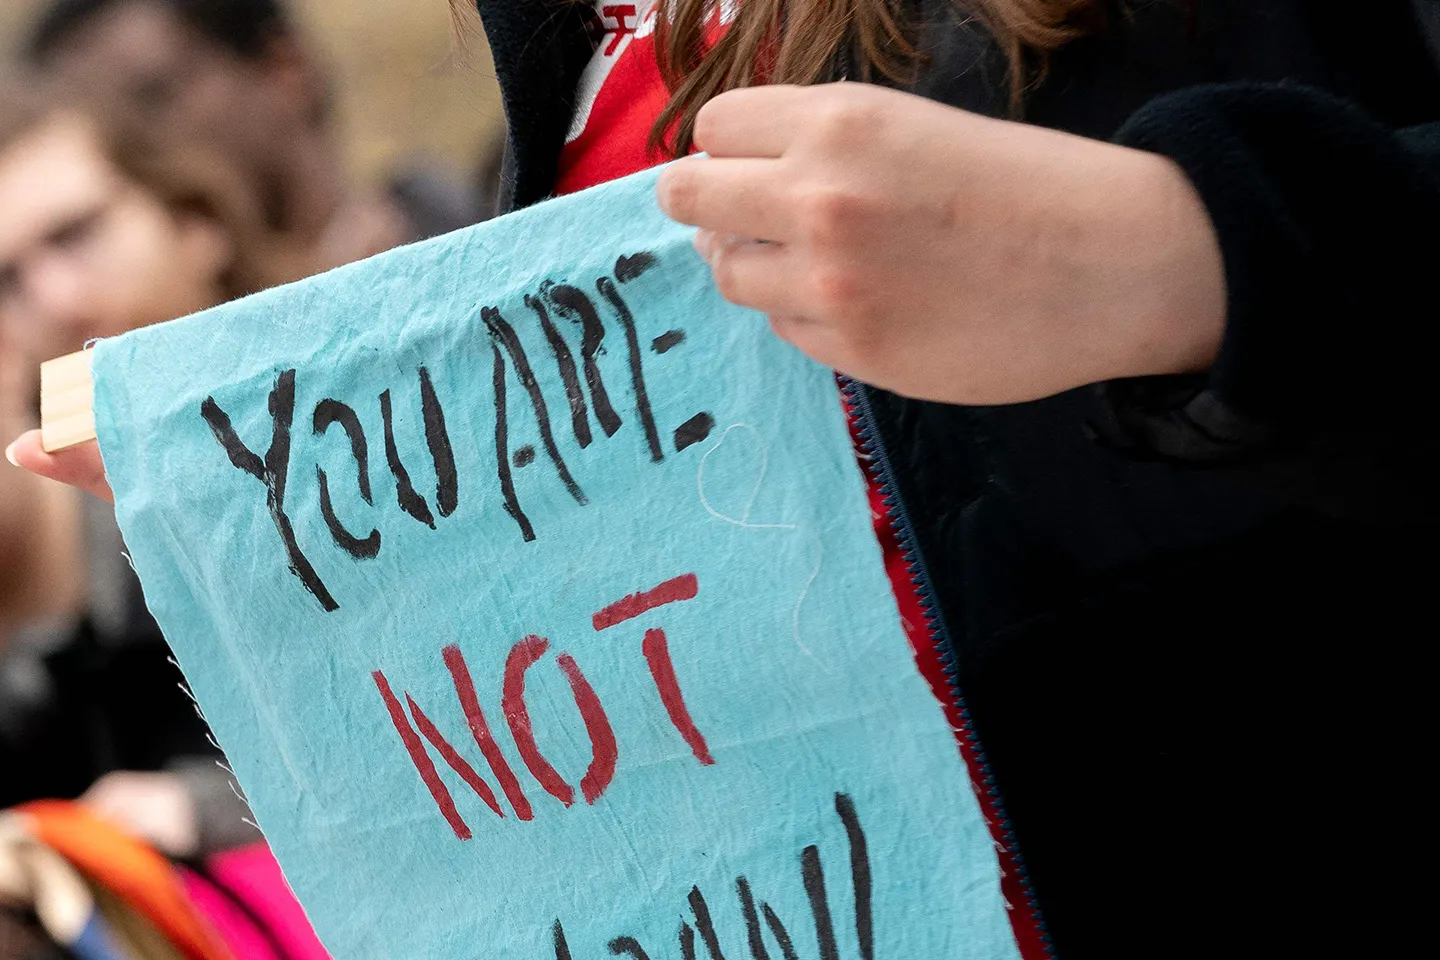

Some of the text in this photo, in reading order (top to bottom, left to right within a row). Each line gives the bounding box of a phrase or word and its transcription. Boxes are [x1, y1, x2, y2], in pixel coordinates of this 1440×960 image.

[201, 252, 715, 612] YOU ARE
[374, 575, 713, 839] NOT
